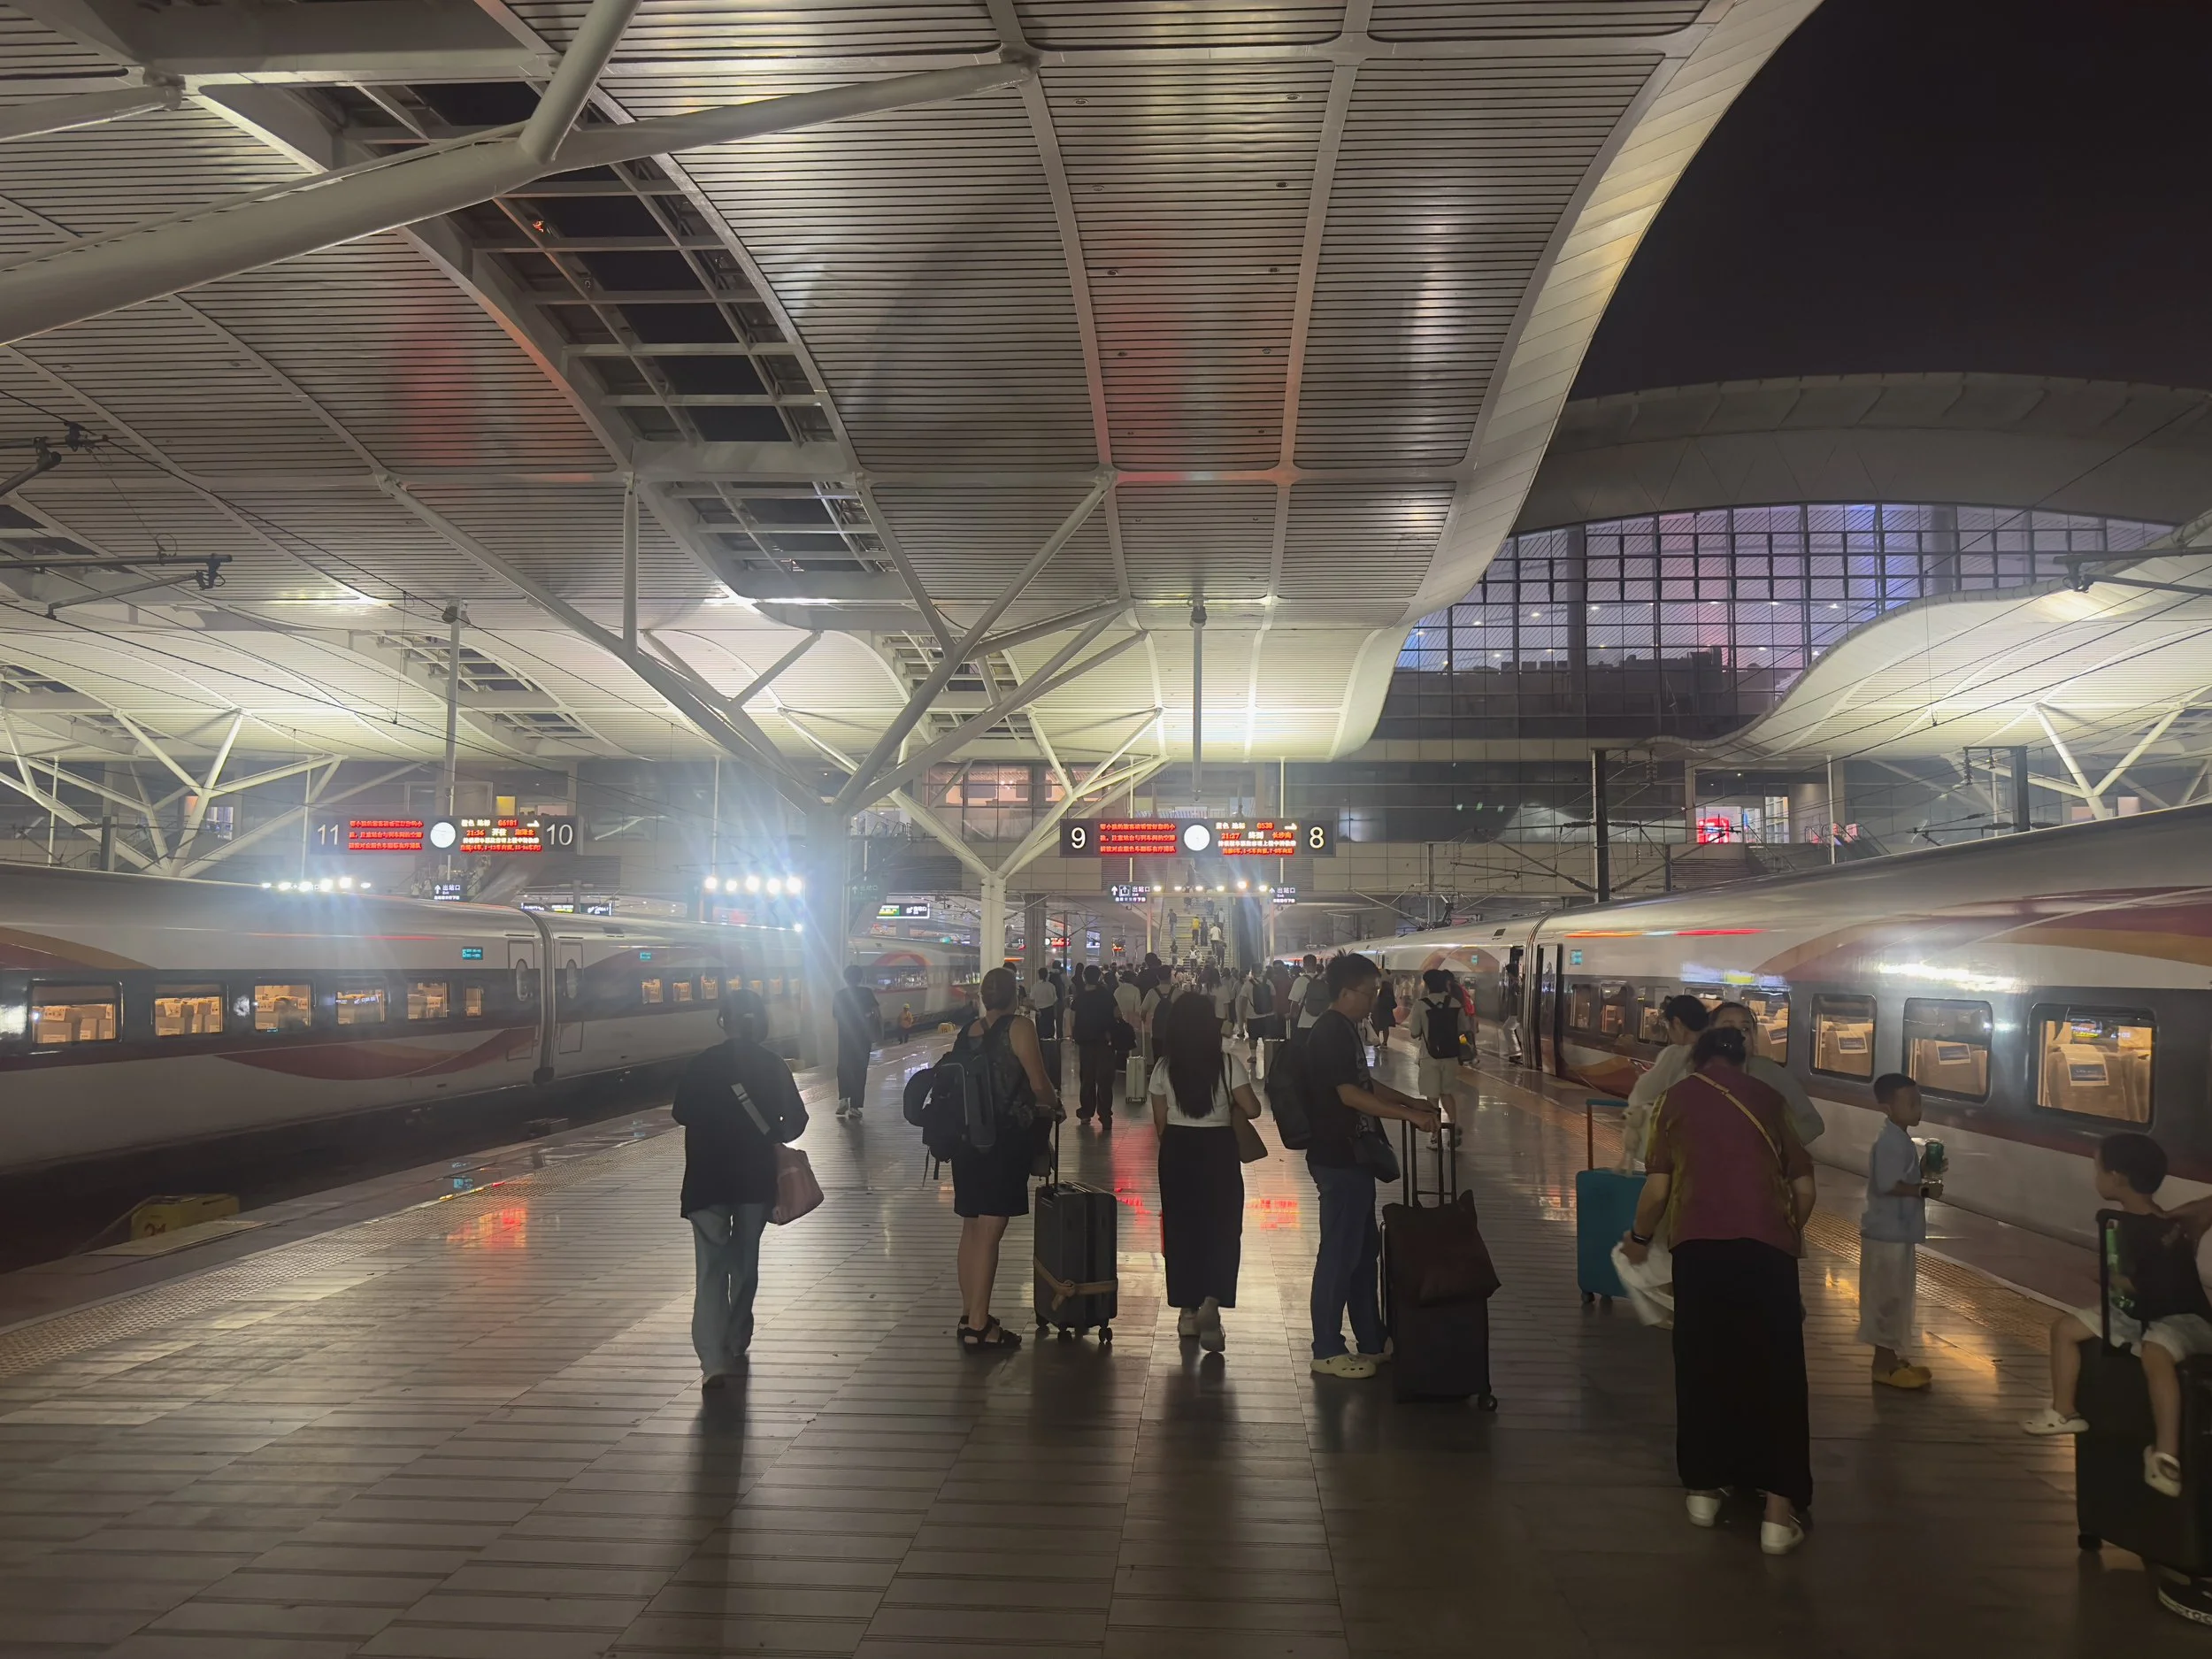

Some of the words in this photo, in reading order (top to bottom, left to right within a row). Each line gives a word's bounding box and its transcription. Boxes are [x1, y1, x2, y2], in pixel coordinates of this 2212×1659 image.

[317, 824, 340, 846] 11
[546, 824, 573, 846] 10
[1071, 827, 1087, 849] 9
[1309, 826, 1325, 849] 8
